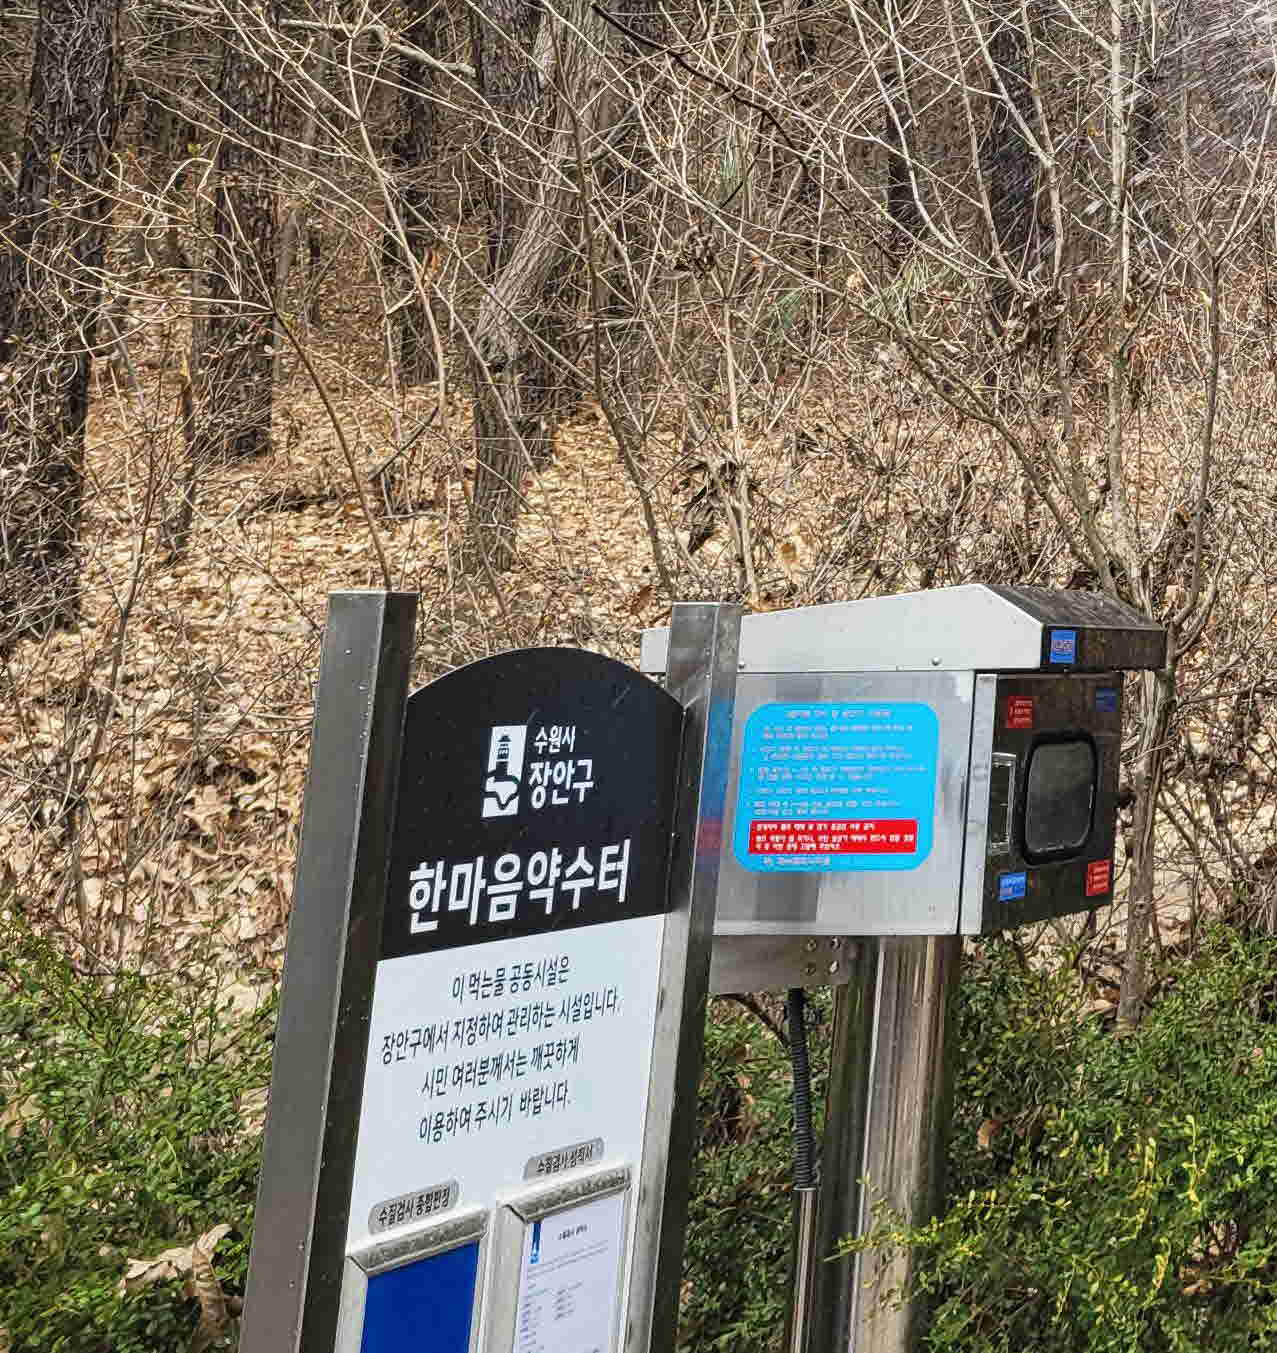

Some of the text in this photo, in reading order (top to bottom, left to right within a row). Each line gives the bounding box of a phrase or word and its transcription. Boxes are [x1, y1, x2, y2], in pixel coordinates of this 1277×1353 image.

[528, 758, 594, 809] 장안구
[409, 838, 631, 935] 한마음약수터
[452, 955, 570, 1002] 이 먹는물 공동시설은
[381, 986, 621, 1065] 장안구에서 지정하여 관리하는 시설입니다.
[421, 1034, 580, 1099] 시민 여러분께서는 깨끗하게
[418, 1103, 473, 1144] 이용하여
[474, 1094, 513, 1129] 주시기
